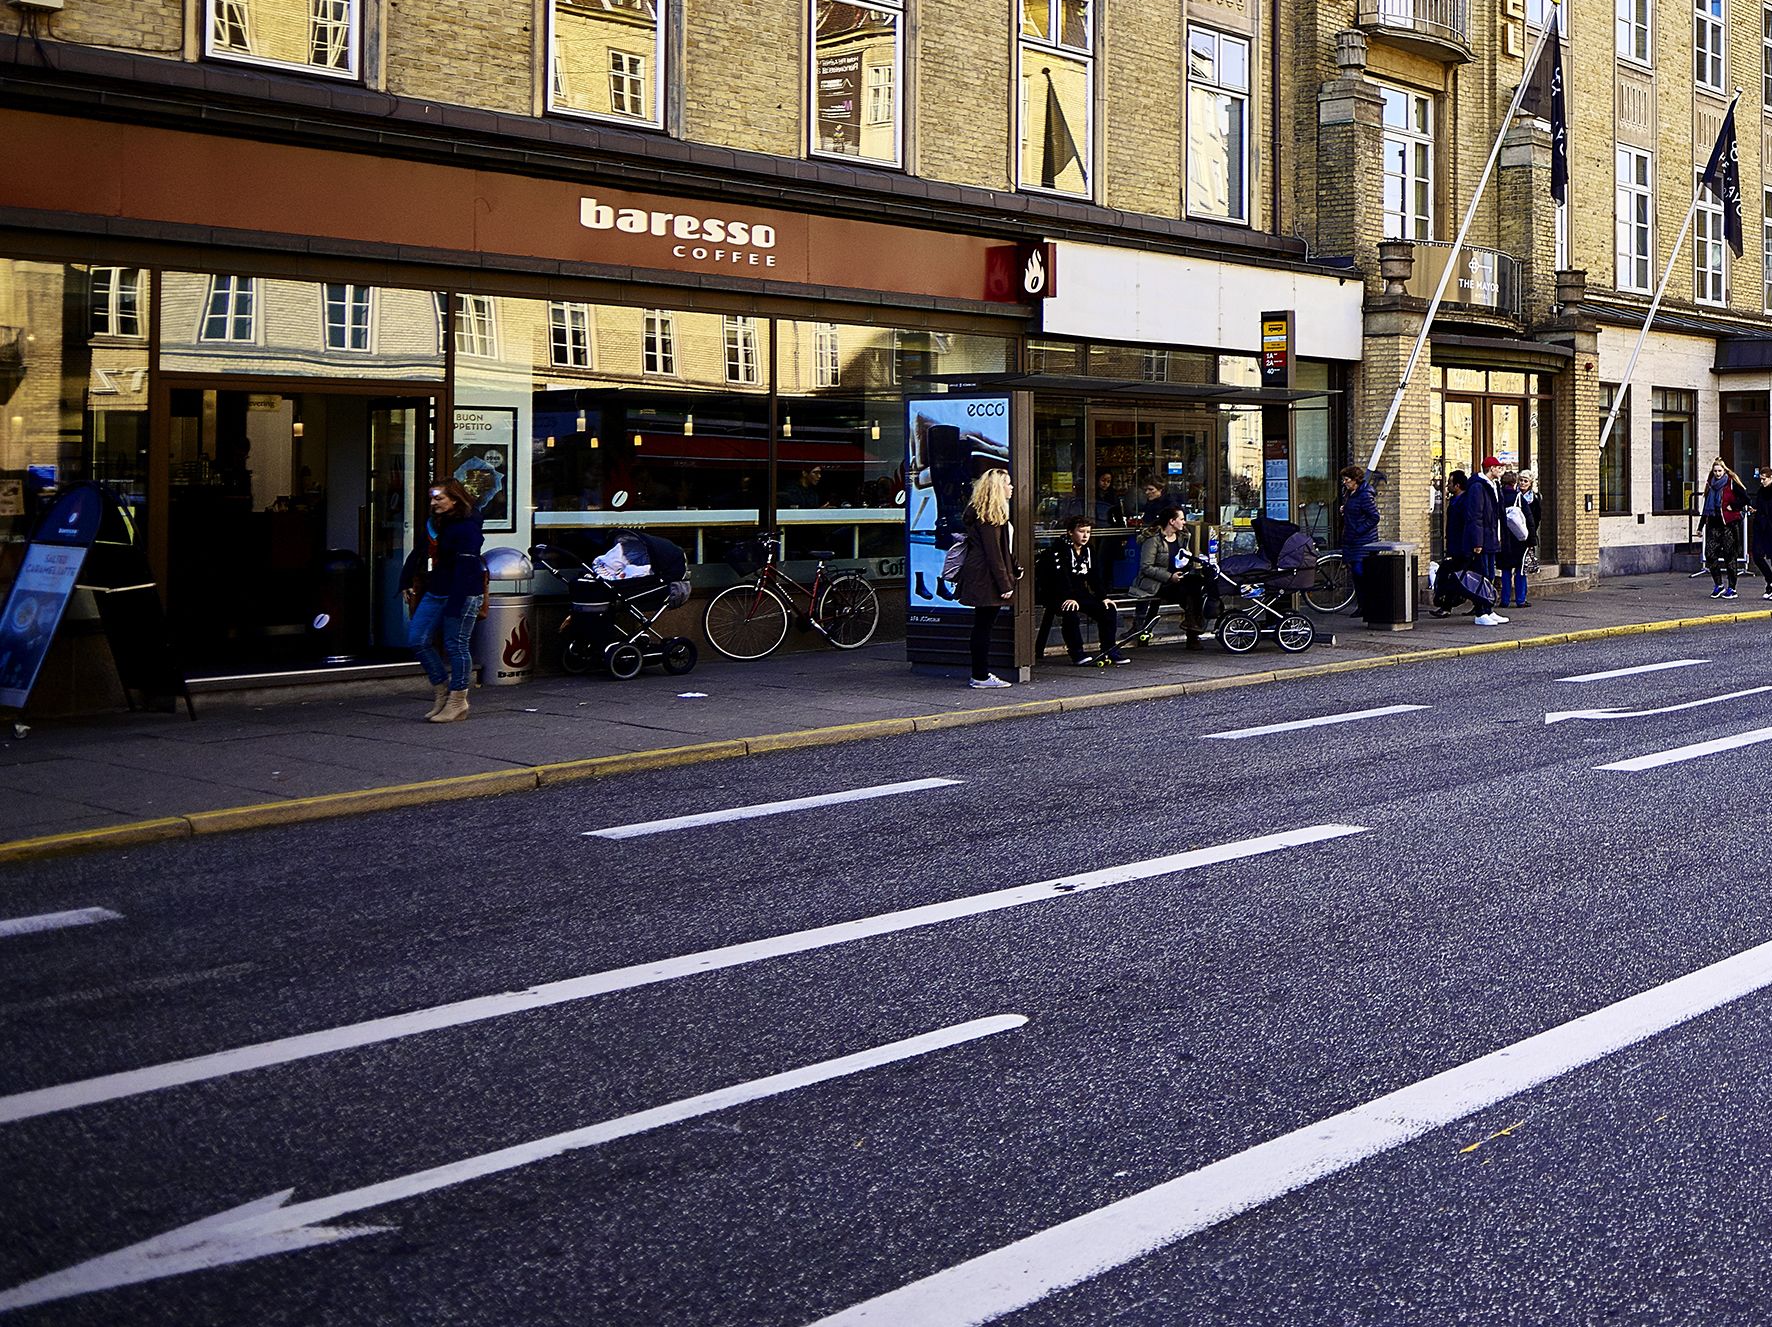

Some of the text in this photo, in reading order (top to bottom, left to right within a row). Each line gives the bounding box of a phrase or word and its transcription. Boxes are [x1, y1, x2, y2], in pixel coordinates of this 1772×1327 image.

[579, 197, 776, 249] baresso
[672, 245, 776, 267] COFFEE
[1458, 278, 1499, 293] THE MAYOR
[967, 403, 1005, 417] ecco
[456, 413, 484, 422] BUON
[453, 422, 493, 431] PPETITO
